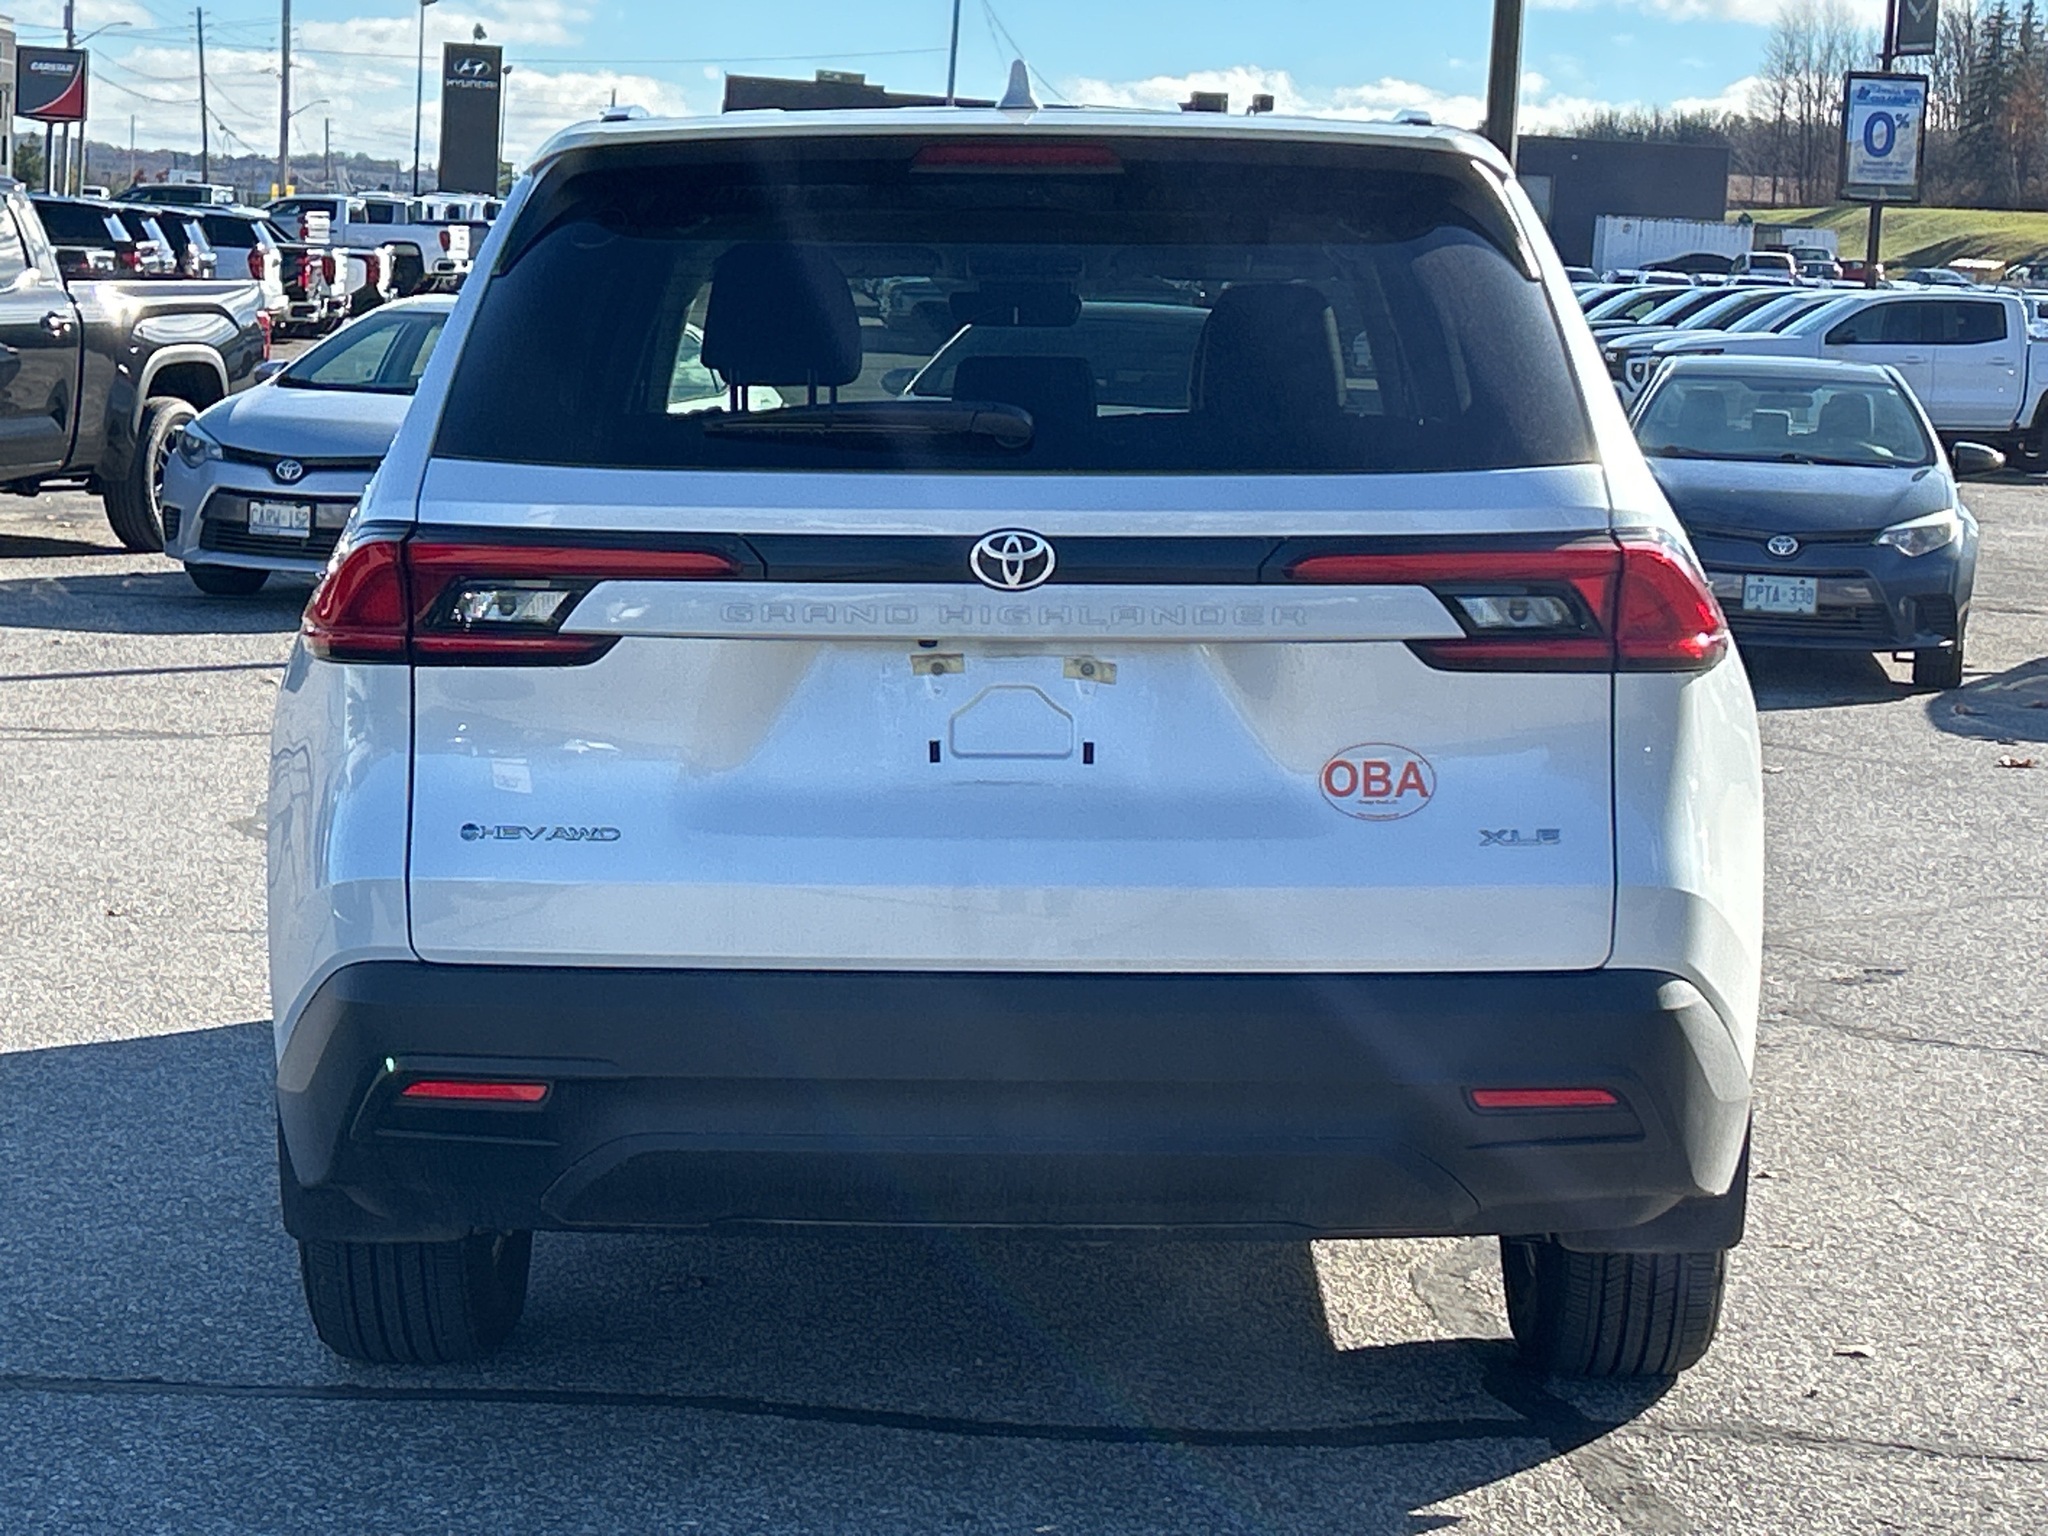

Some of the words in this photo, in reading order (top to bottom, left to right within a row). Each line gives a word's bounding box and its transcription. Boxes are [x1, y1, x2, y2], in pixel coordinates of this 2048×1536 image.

[446, 78, 498, 89] HYUNDAI
[1747, 585, 1780, 603] CPTA
[720, 603, 919, 624] GRAND
[938, 604, 1309, 627] HIGHLANDER
[1323, 760, 1430, 798] OBA
[1479, 828, 1561, 847] XLE
